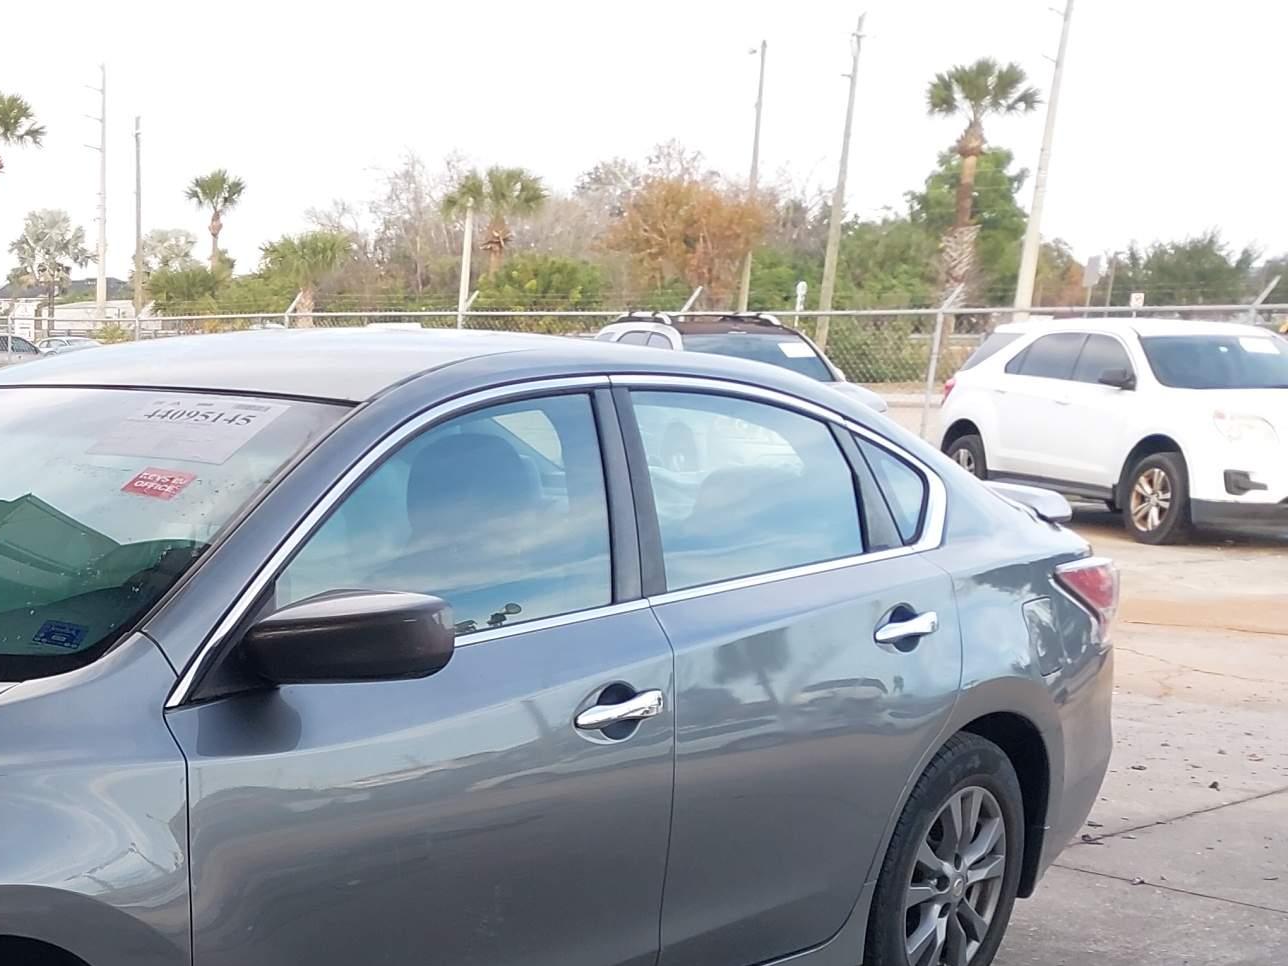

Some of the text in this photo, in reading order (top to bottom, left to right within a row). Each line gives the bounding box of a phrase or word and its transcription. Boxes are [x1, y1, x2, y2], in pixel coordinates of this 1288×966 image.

[144, 408, 257, 426] 44095145
[138, 472, 169, 483] KEYS
[134, 480, 176, 493] OFFICE
